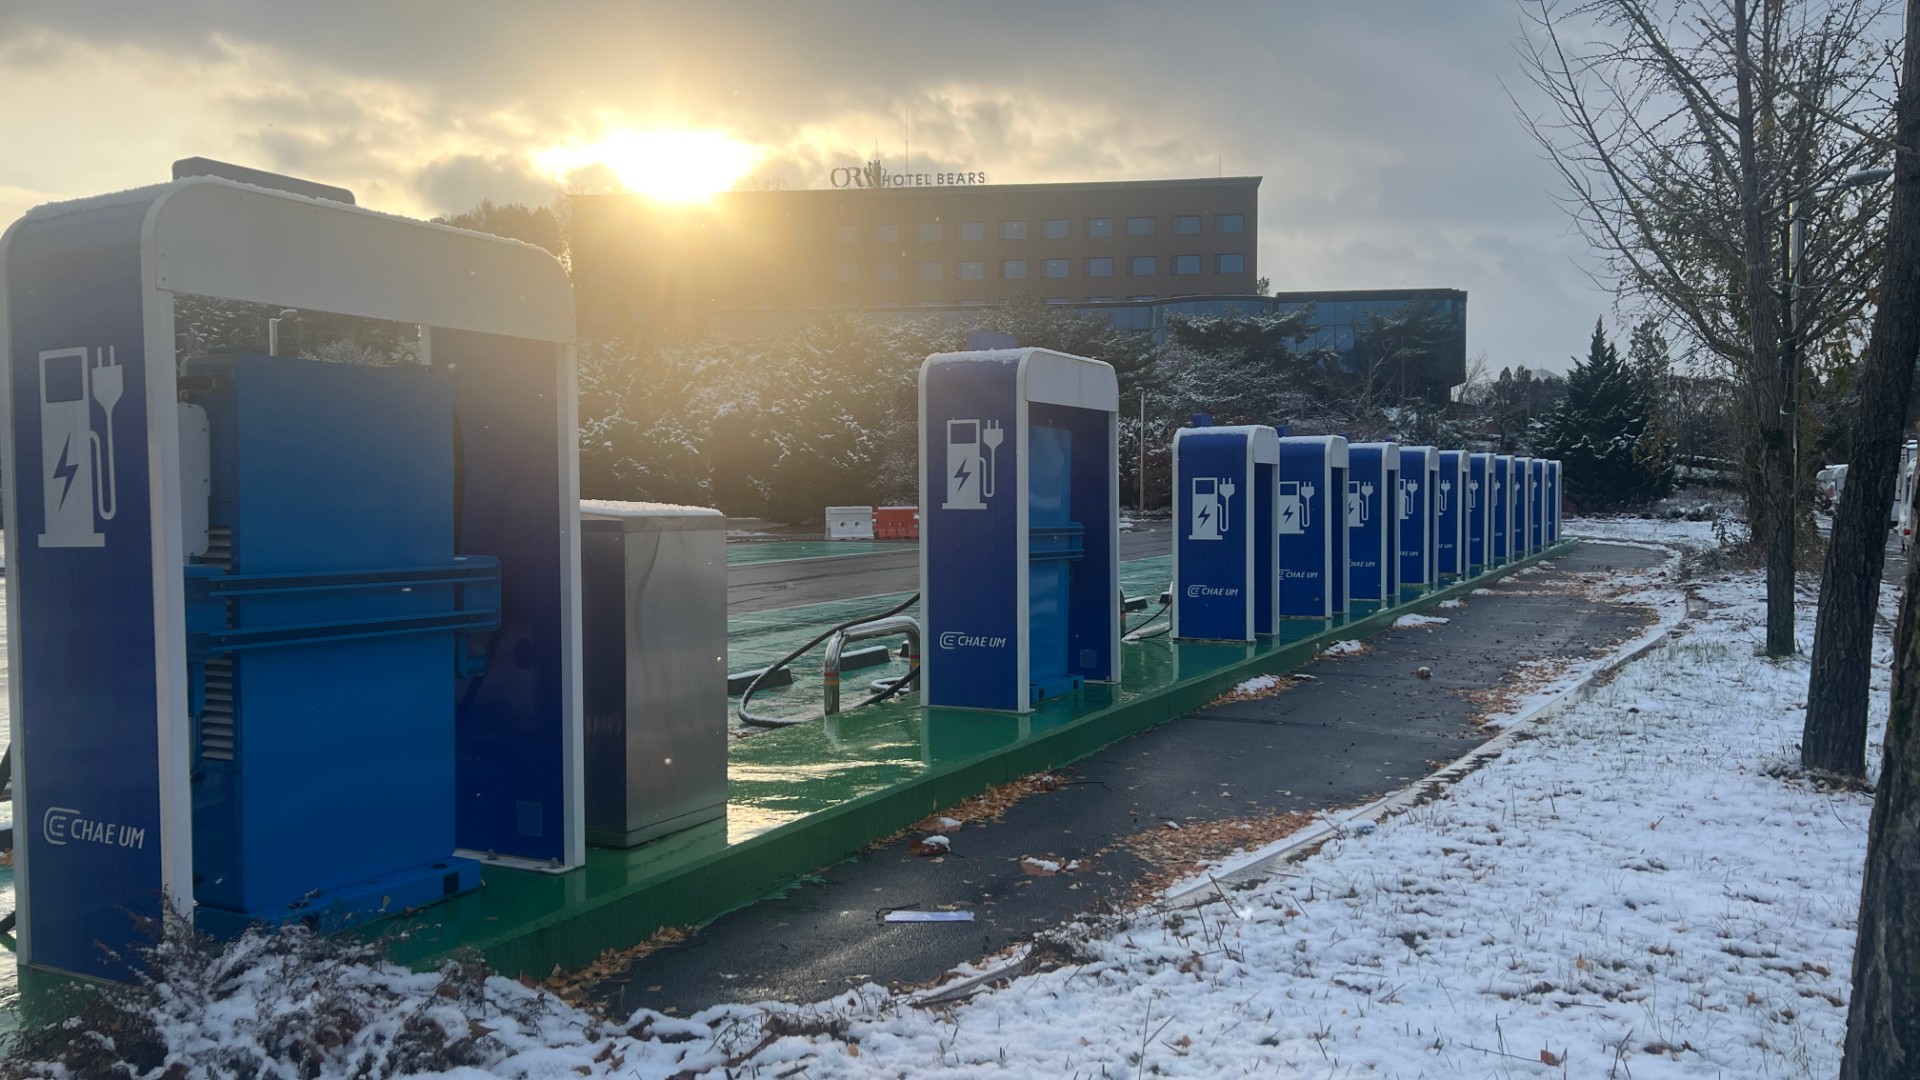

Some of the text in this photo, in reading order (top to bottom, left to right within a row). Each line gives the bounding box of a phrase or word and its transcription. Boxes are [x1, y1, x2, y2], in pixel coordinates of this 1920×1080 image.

[882, 172, 985, 186] HOTEL BEARS
[1201, 587, 1239, 596] CHAE UM
[957, 636, 1007, 648] CHAE UM
[71, 818, 145, 849] CHAE UM
